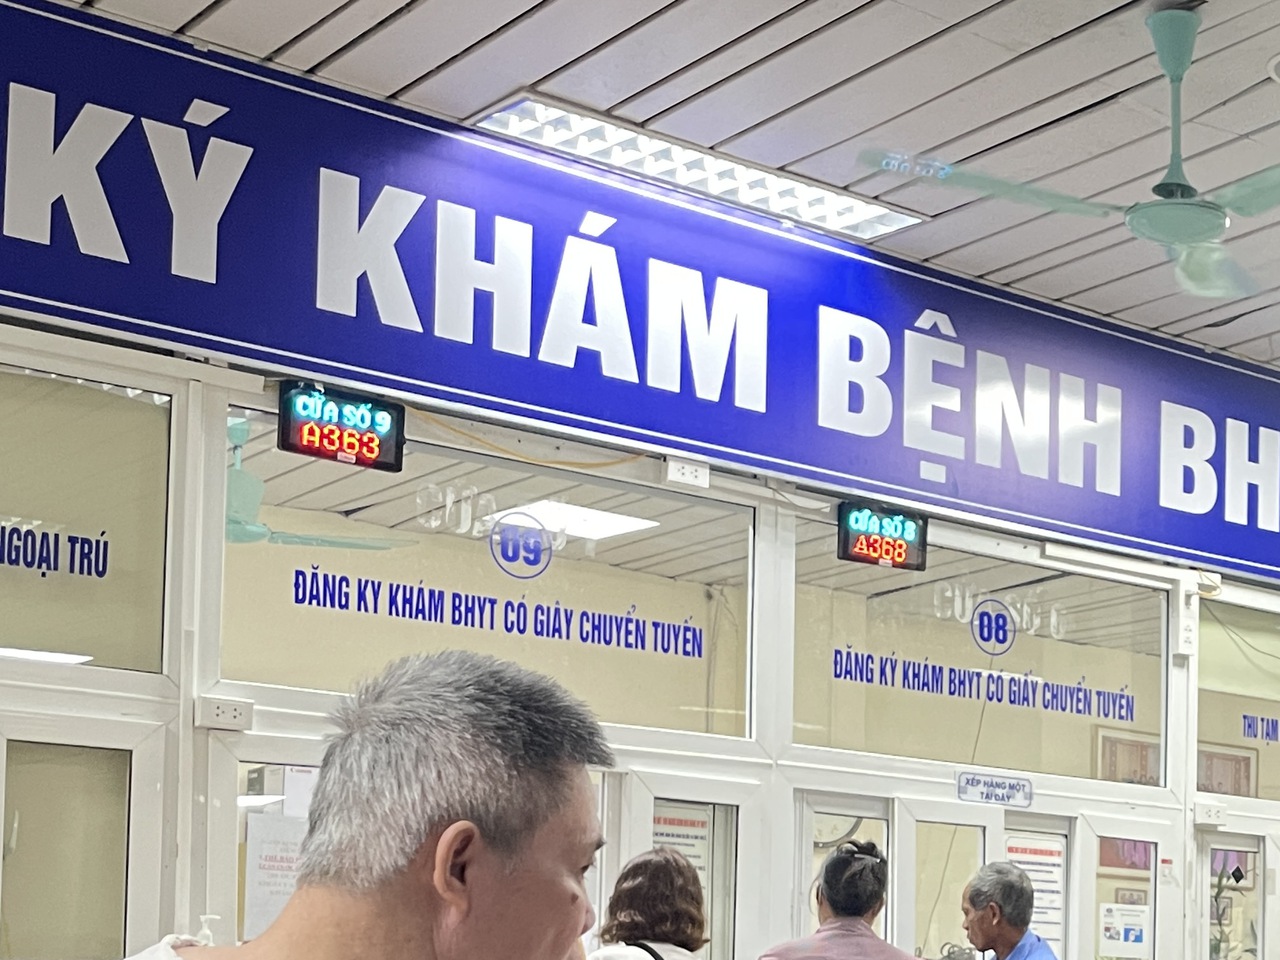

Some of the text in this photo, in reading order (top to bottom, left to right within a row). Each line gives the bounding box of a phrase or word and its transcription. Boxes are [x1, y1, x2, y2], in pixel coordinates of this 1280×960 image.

[3, 82, 253, 284] KÝ
[316, 167, 768, 412] KHÁM
[818, 305, 1122, 496] BỆNH
[375, 411, 391, 433] 9
[302, 421, 380, 459] A363
[501, 526, 542, 566] 09
[904, 521, 916, 540] 8
[68, 531, 108, 578] TRÚ
[854, 535, 907, 562] A368
[294, 564, 350, 610] ĐĂNG
[388, 580, 444, 623] KHÁM
[452, 592, 497, 630] BHYT
[504, 594, 527, 634] CÓ
[580, 604, 646, 651] CHUYỂN
[652, 616, 702, 658] TUYẾN
[979, 611, 1007, 644] 08
[834, 643, 1134, 722] ĐĂNG KÝ KHÁM BHYT CÓ GIẤY CHUYỂN TUYẾN
[1243, 715, 1258, 738] THU
[1261, 717, 1278, 746] TẠM
[965, 775, 1026, 793] XẾP HÀNG MỘT
